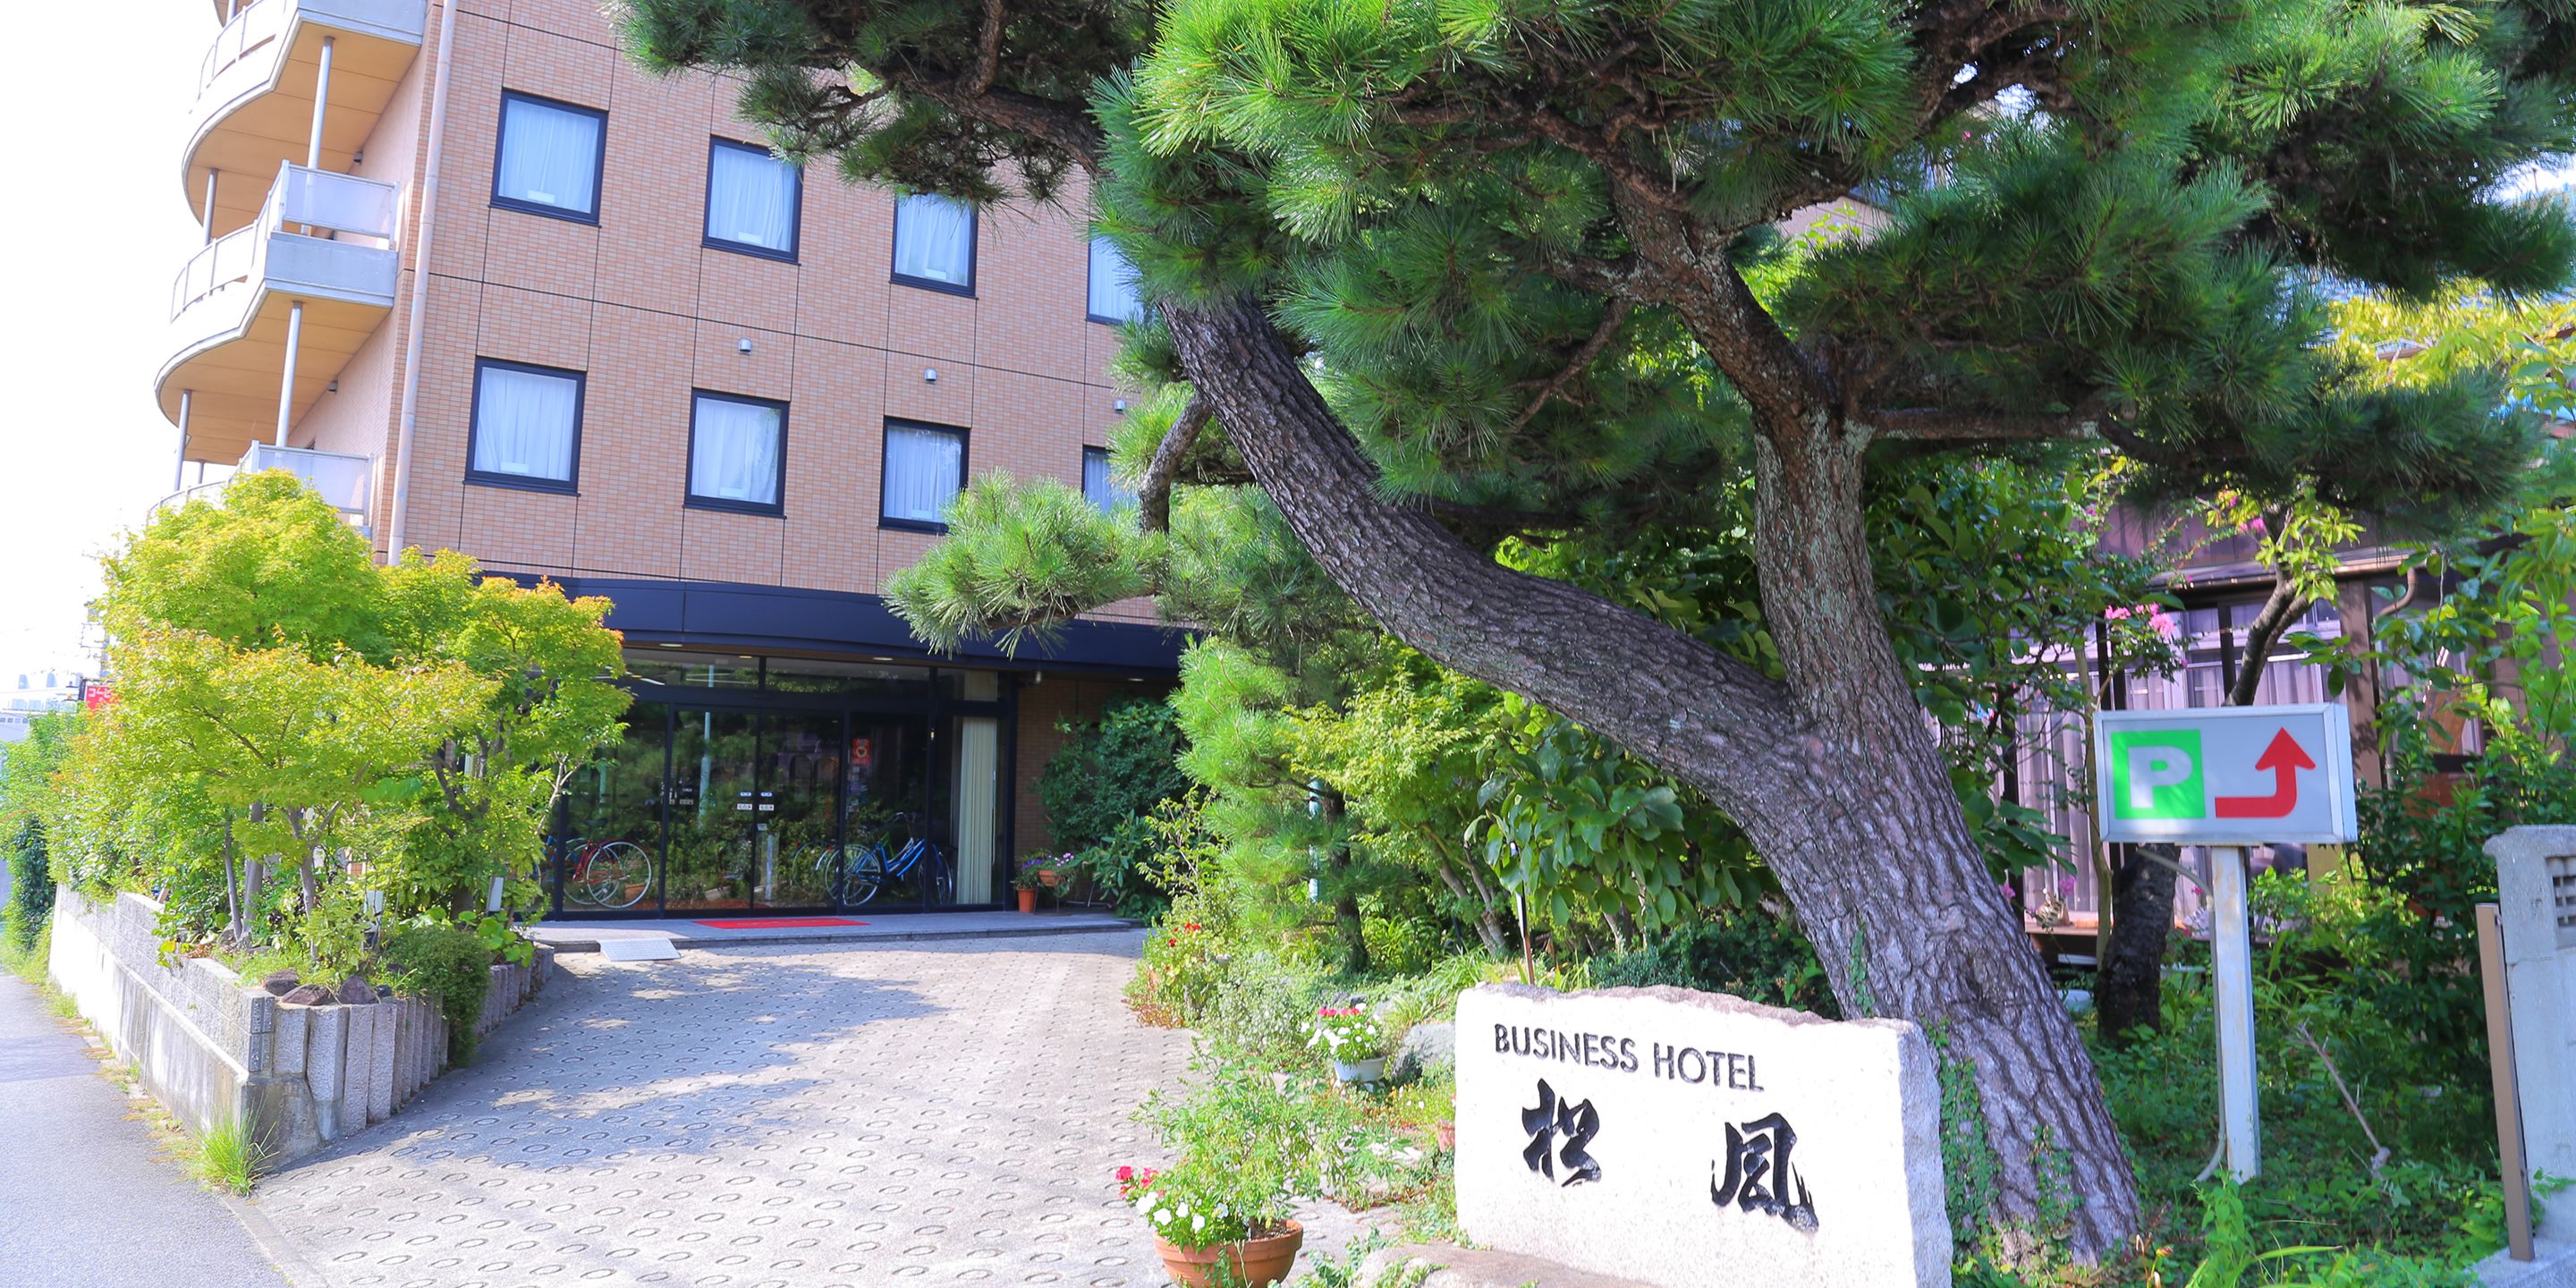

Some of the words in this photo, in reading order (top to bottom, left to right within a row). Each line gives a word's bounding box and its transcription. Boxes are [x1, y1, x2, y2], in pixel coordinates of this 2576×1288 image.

[2128, 746, 2191, 809] P
[1494, 1023, 1640, 1072] BUSINESS
[1653, 1042, 1765, 1091] HOTEL
